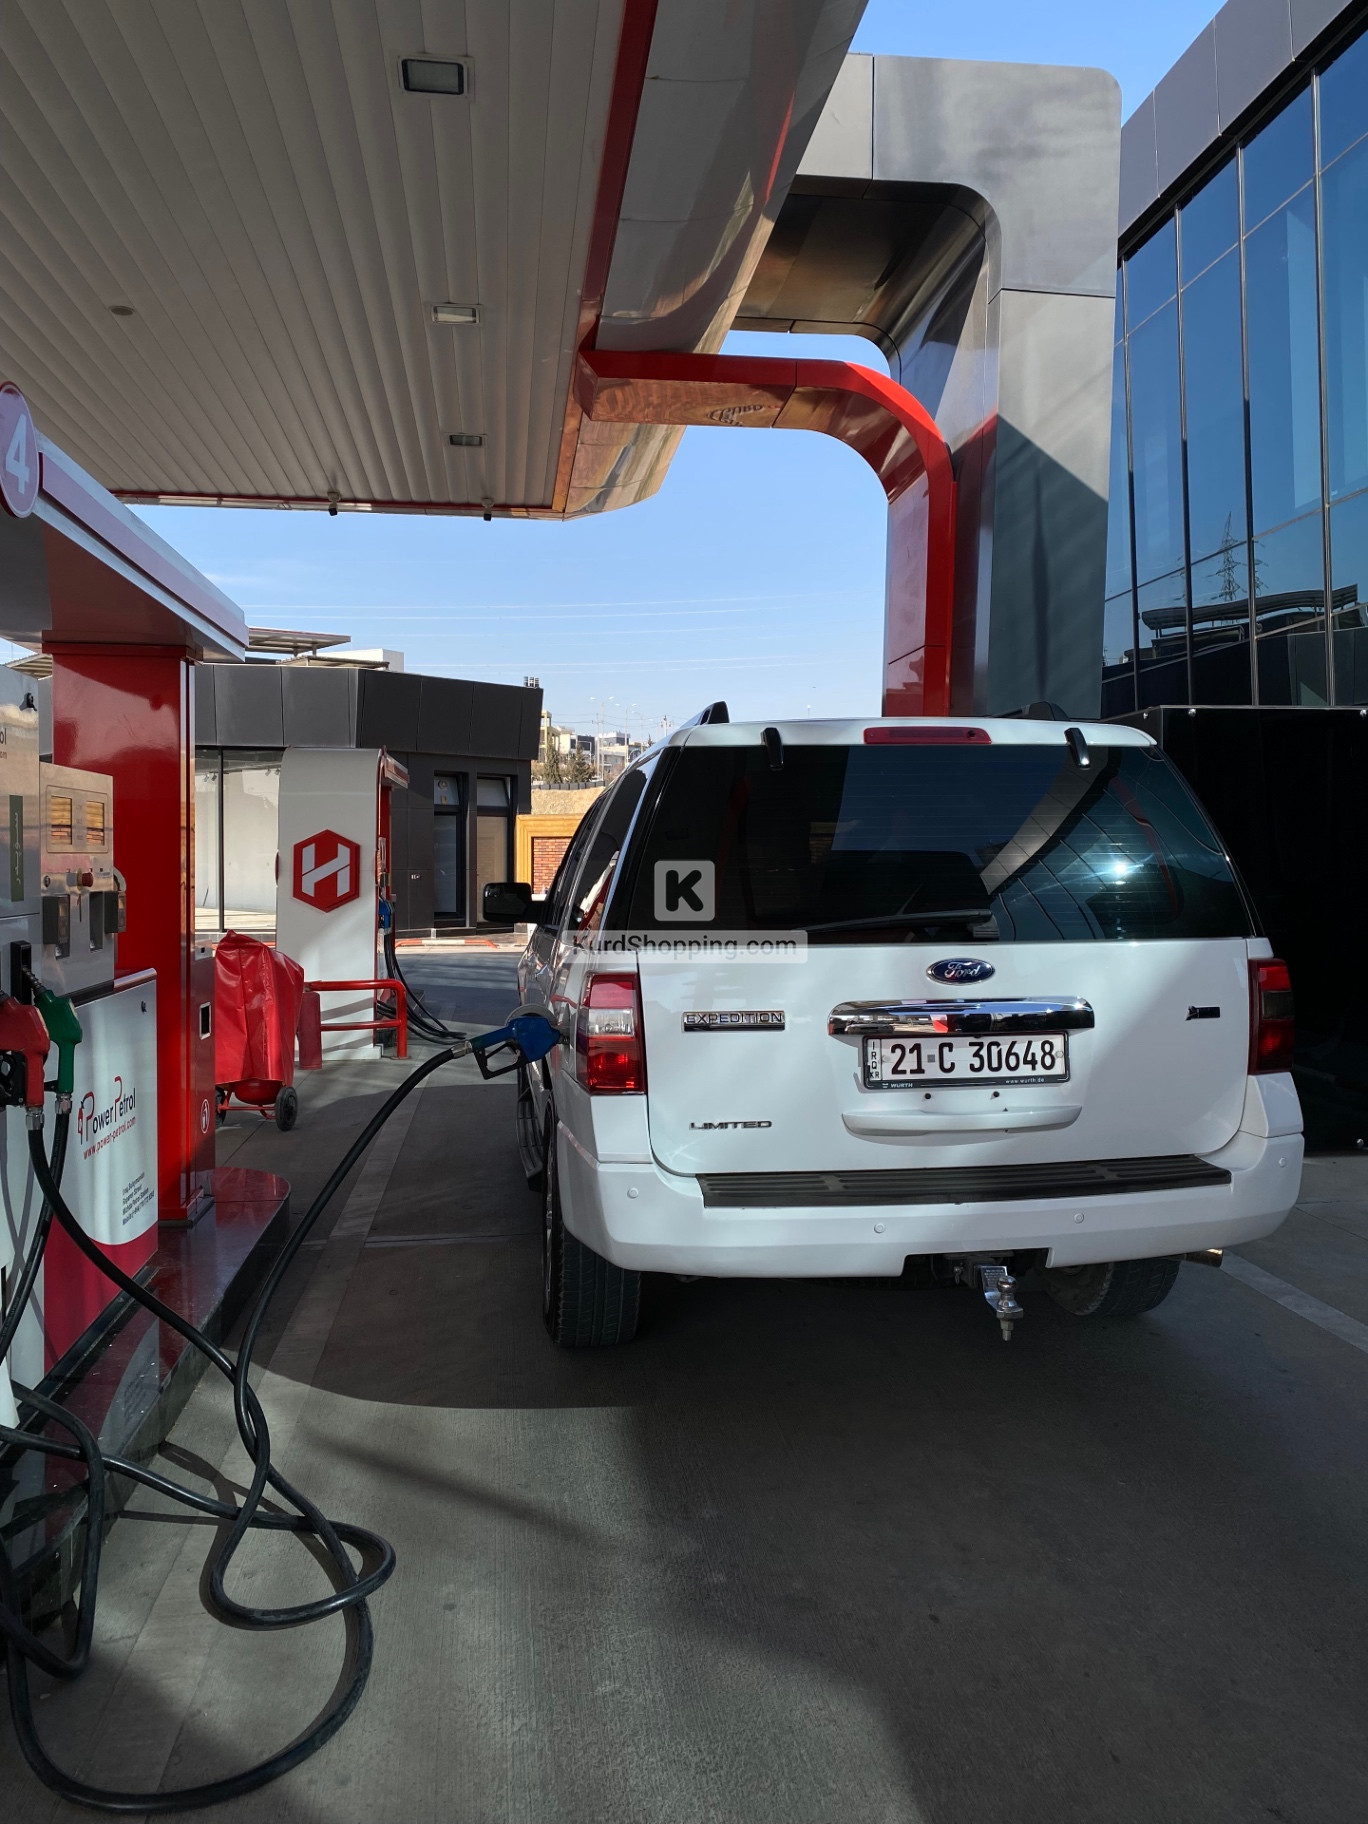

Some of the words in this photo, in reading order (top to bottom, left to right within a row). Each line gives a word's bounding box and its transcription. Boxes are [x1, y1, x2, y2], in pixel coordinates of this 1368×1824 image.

[6, 413, 30, 494] 4
[944, 961, 981, 979] Ford
[686, 1012, 783, 1024] EXPEDITION
[890, 1042, 926, 1075] 21
[938, 1041, 956, 1074] C
[968, 1039, 1056, 1073] 30648
[689, 1120, 772, 1130] LIMITED
